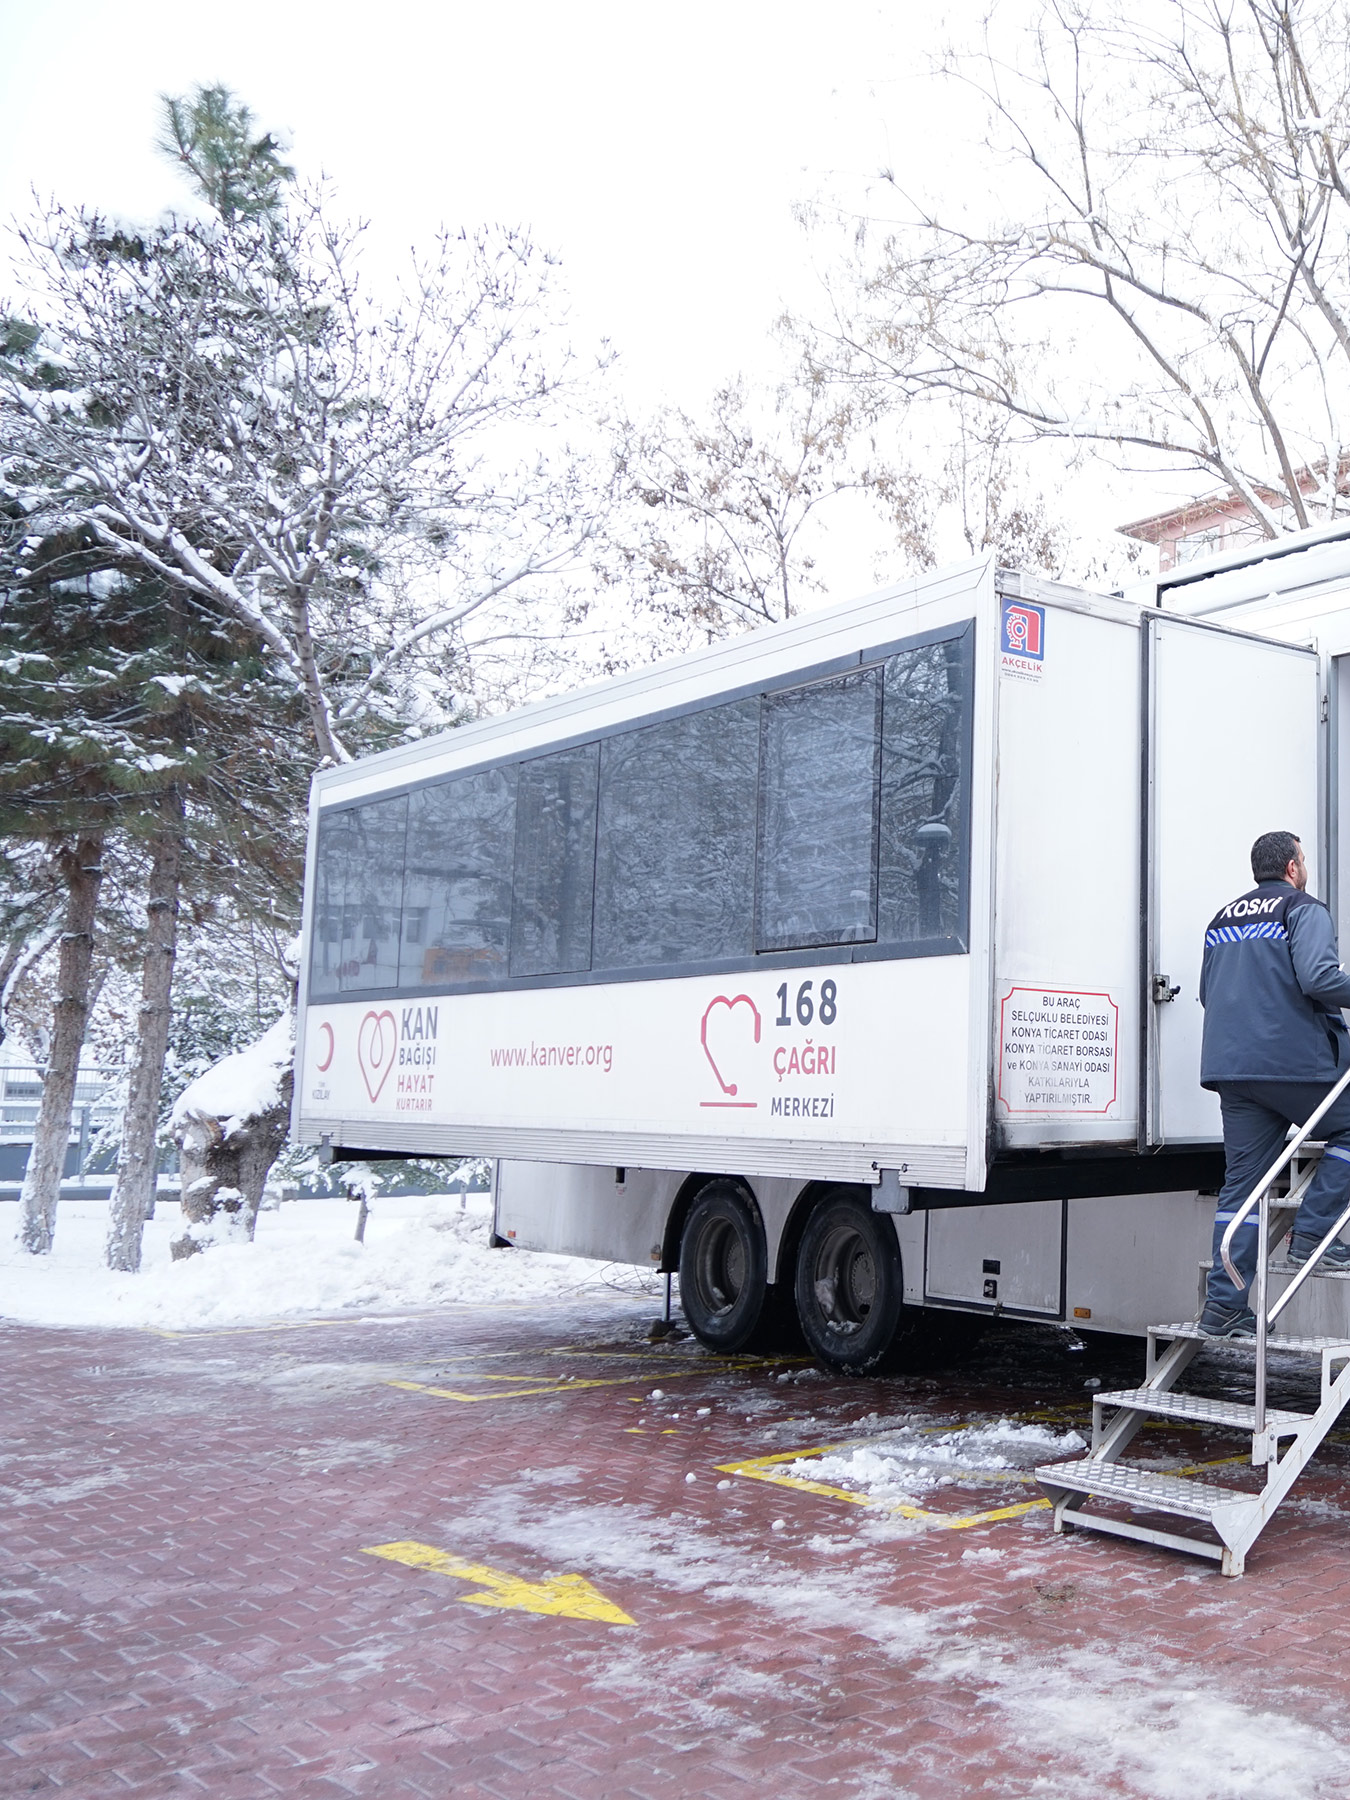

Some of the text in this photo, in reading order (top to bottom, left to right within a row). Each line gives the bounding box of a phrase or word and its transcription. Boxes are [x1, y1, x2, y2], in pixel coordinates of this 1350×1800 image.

[1219, 896, 1284, 920] KOSKİ
[775, 978, 838, 1027] 168
[1042, 996, 1081, 1011] BU ARAÇ
[400, 1005, 439, 1041] KAN
[1011, 1009, 1109, 1026] SELÇUKLU BELEDİYESİ
[1011, 1026, 1108, 1042] KONYA TİCARET ODASI
[398, 1041, 437, 1071] BAĞIŞI
[490, 1040, 613, 1073] www.kanver.org
[1005, 1042, 1113, 1058] KONYA TİCARET BORSASI
[772, 1038, 836, 1083] ÇAĞRI
[1007, 1059, 1110, 1073] ve KONYA SANAYİ ODASI
[397, 1074, 435, 1093] HAYAT
[1028, 1076, 1090, 1088] KATKILARIYLA
[395, 1098, 433, 1112] KURTARIR
[770, 1092, 834, 1118] MERKEZİ
